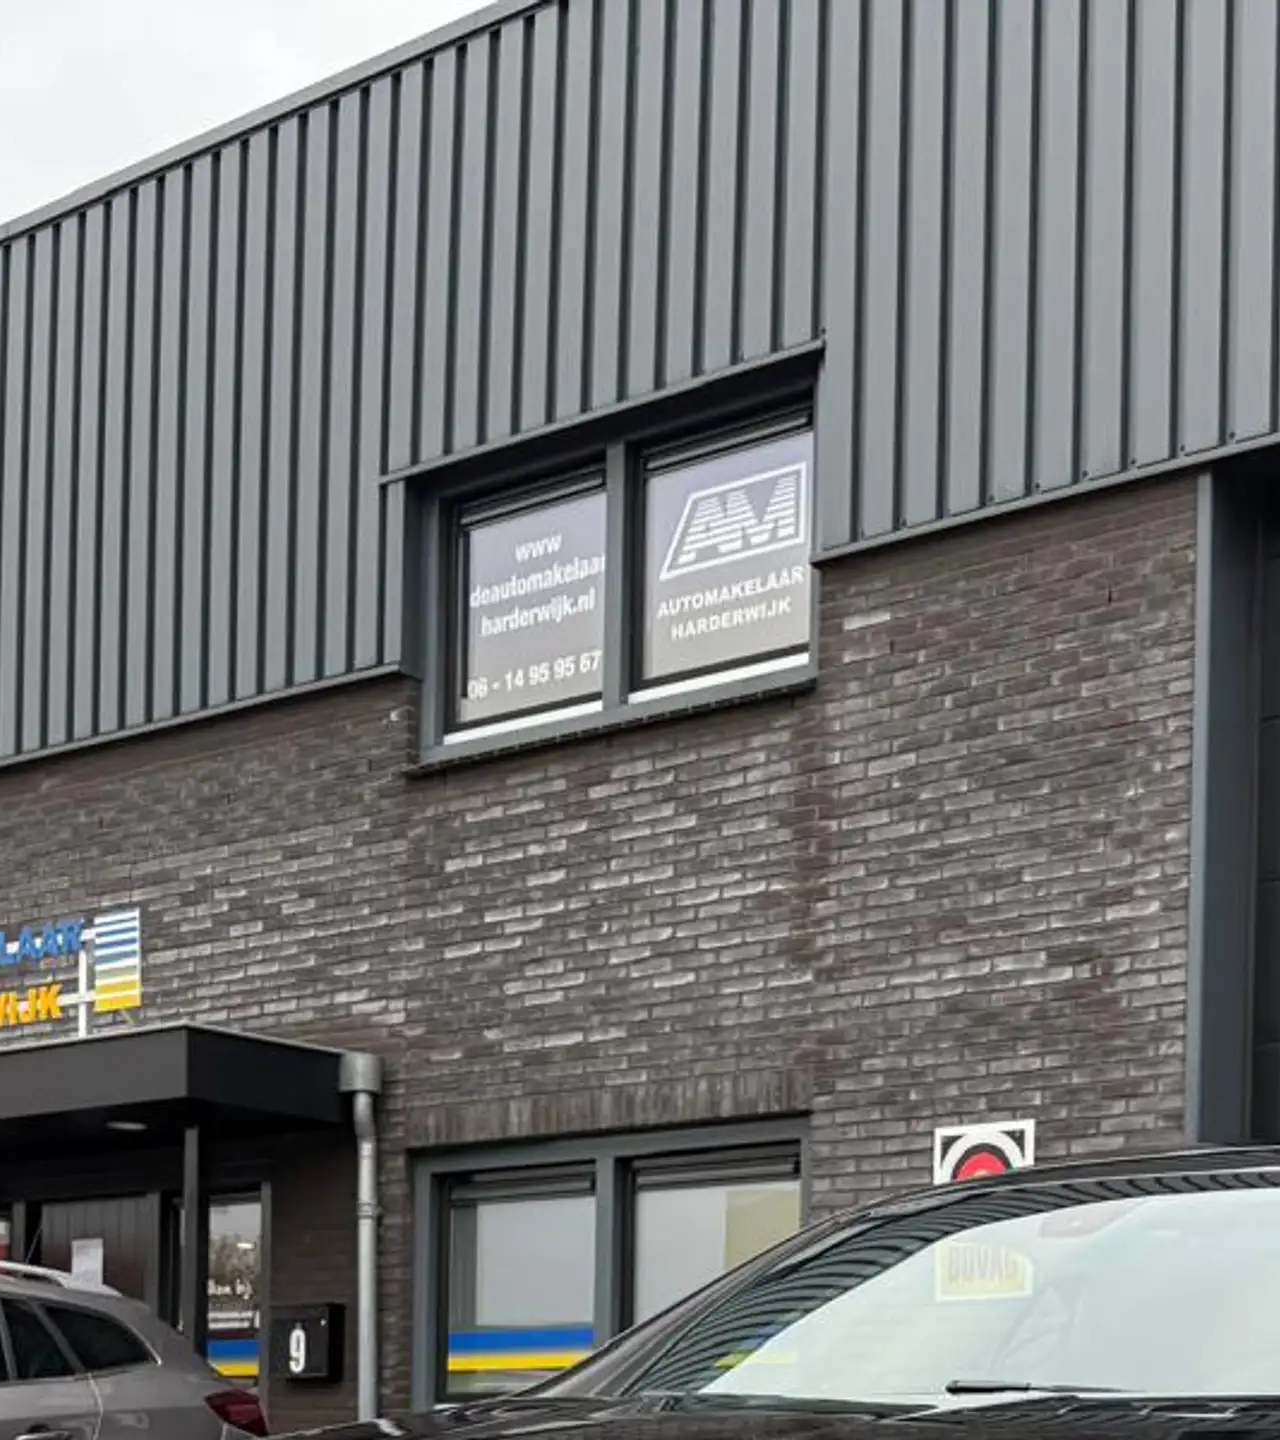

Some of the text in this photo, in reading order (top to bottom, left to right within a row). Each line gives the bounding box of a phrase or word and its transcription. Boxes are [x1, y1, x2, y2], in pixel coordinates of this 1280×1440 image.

[514, 529, 562, 562] www
[481, 586, 596, 637] harderwijk.nl
[657, 565, 805, 619] AUTOMAKELAAR
[671, 595, 793, 641] HARDERWIJK
[504, 668, 524, 692] 14
[528, 661, 550, 686] 95
[553, 655, 575, 679] 95
[288, 1327, 306, 1374] 9
